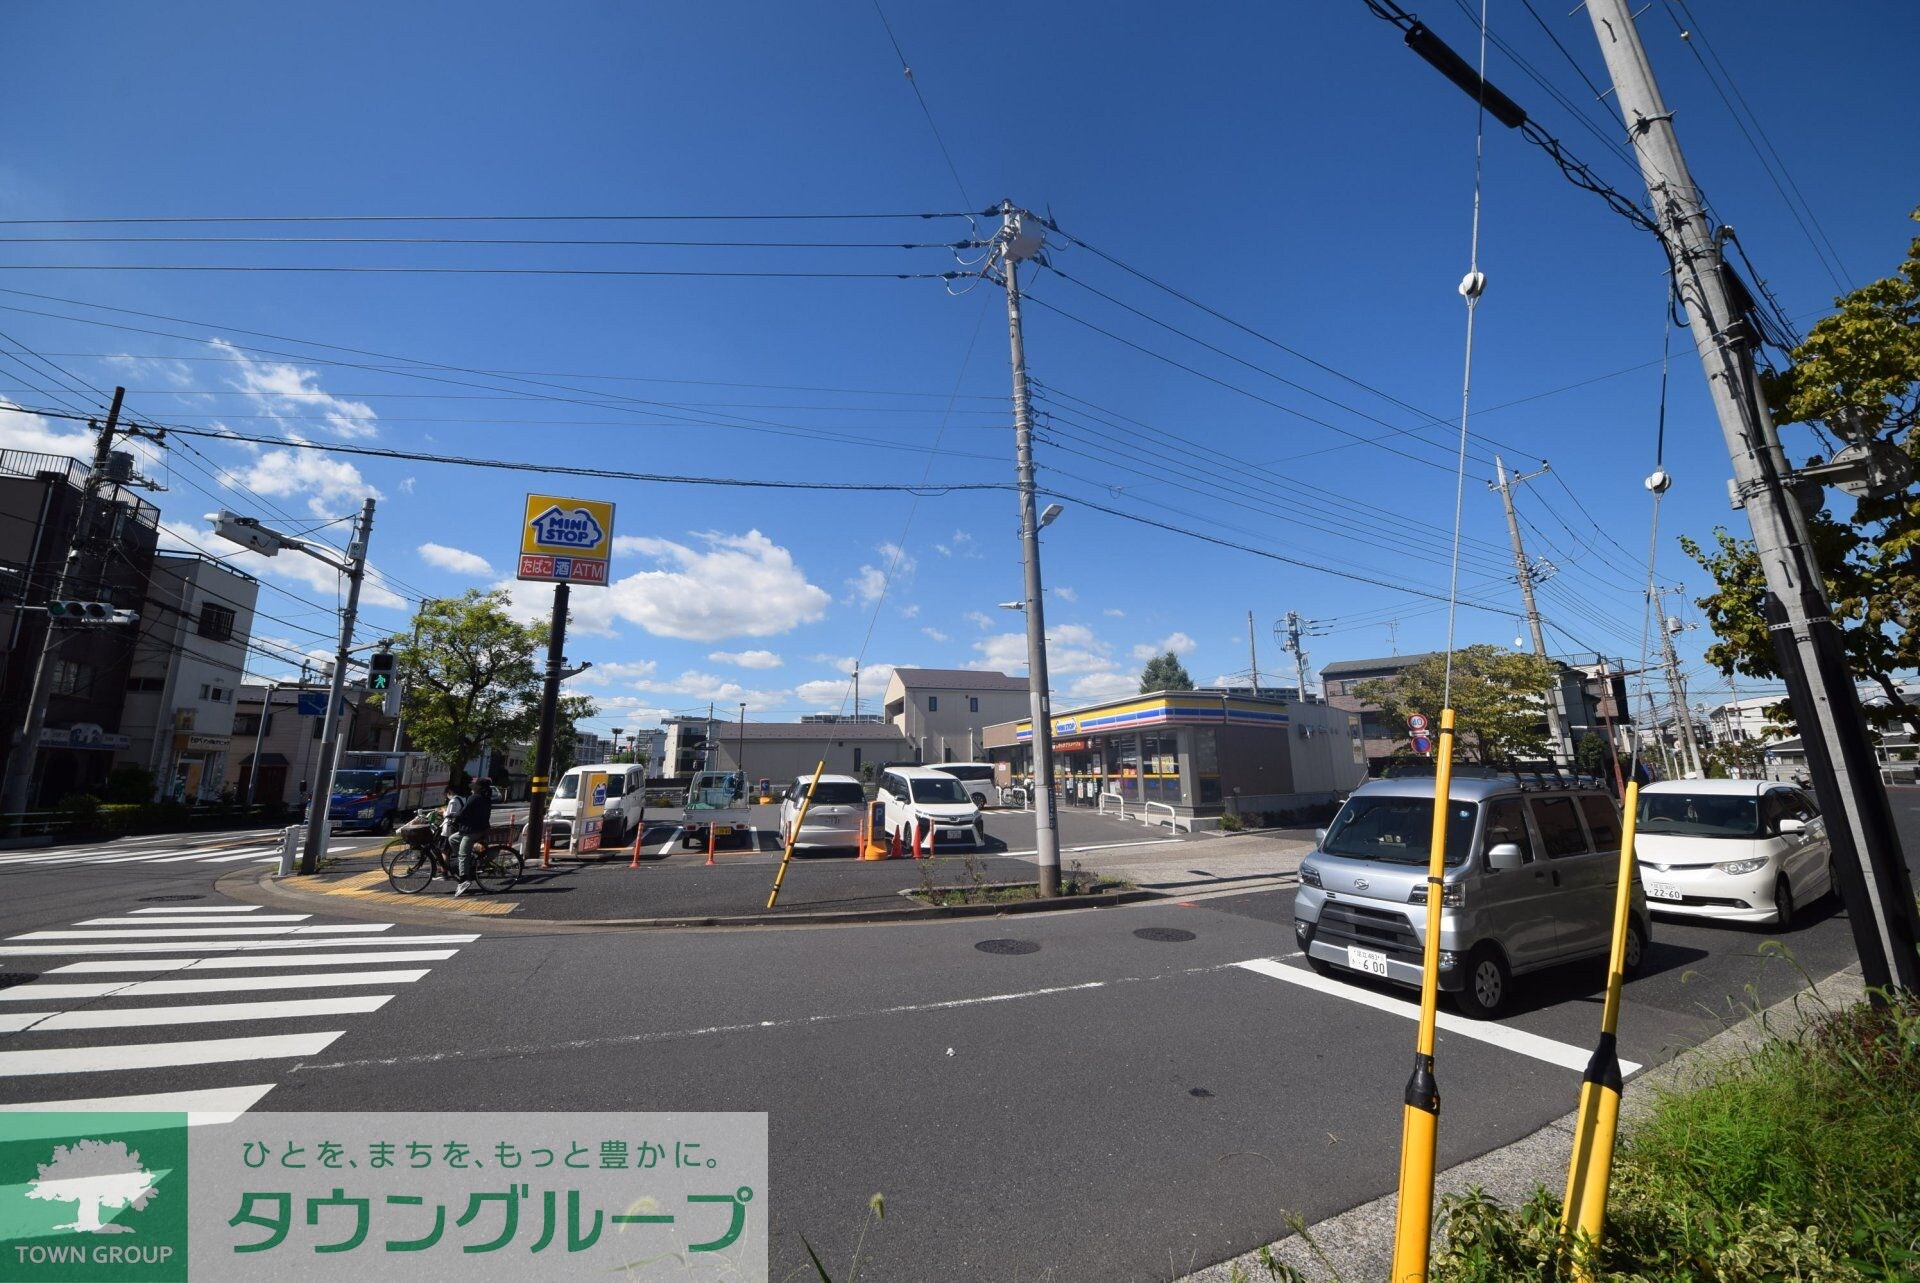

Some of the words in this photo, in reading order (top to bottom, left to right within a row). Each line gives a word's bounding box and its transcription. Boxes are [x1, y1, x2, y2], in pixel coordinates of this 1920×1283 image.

[550, 517, 588, 531] MINI
[546, 528, 589, 542] STOP
[522, 558, 552, 575] たばこ
[555, 560, 570, 576] 酒
[572, 562, 603, 578] ATM
[1411, 718, 1423, 726] 40
[875, 808, 884, 821] P
[1653, 888, 1680, 898] 22-60
